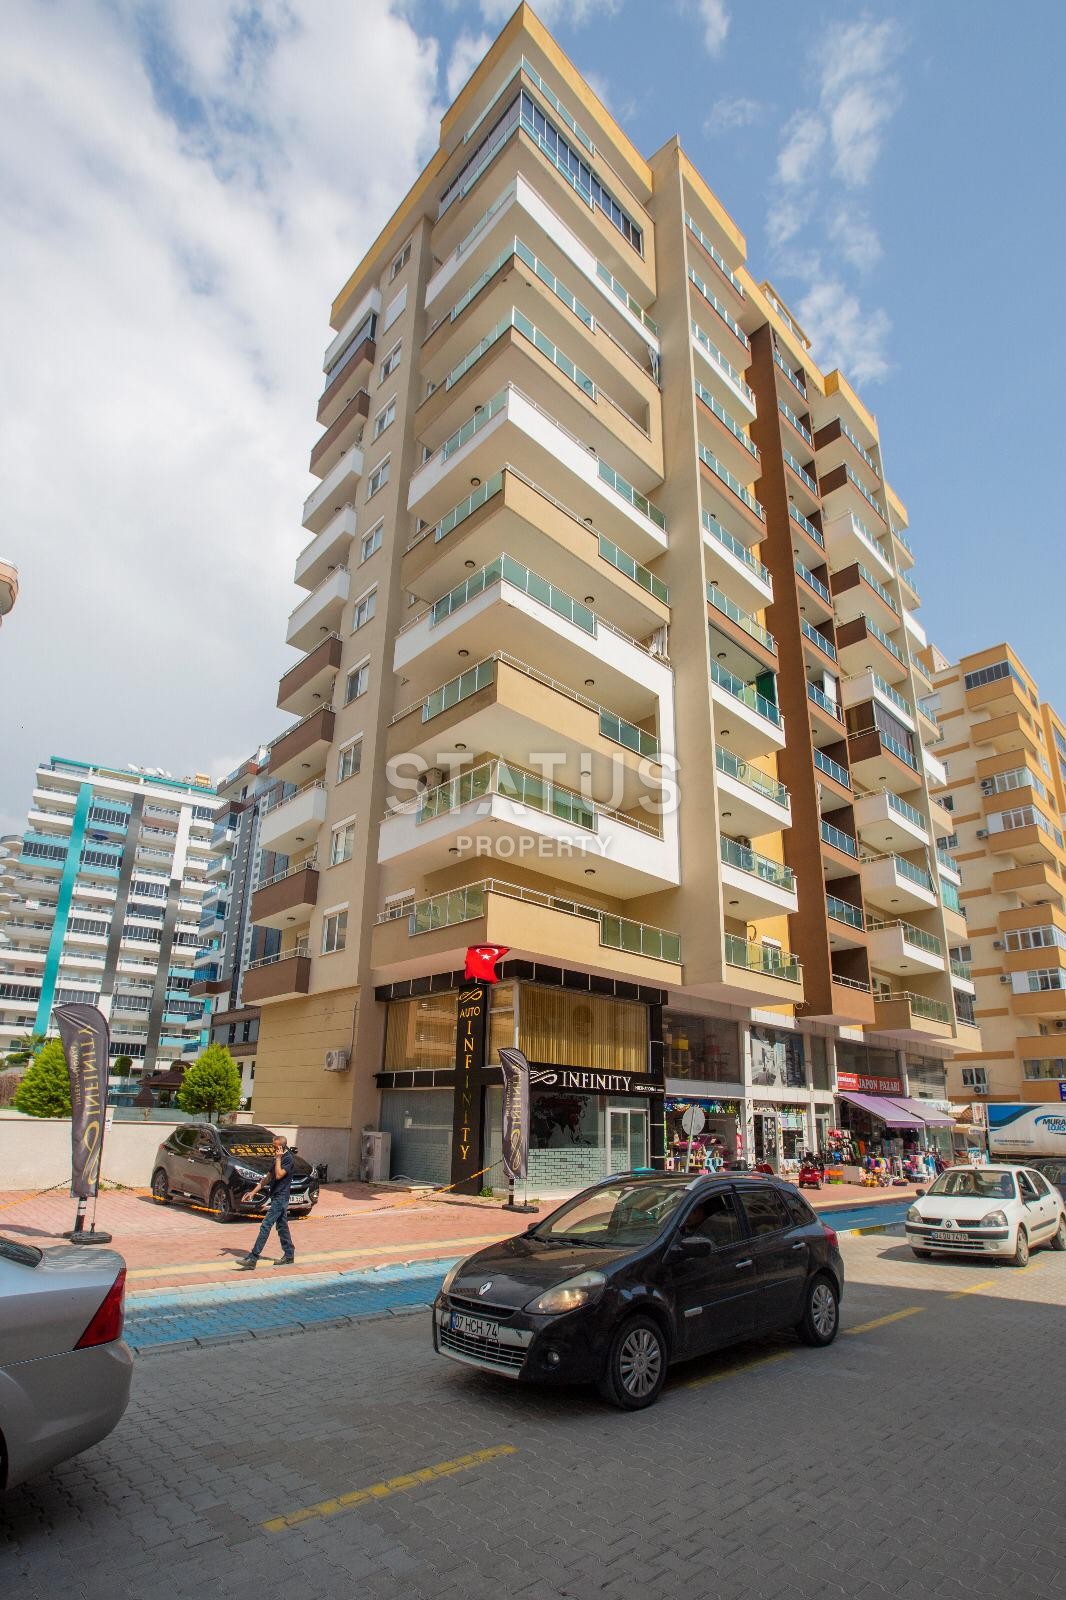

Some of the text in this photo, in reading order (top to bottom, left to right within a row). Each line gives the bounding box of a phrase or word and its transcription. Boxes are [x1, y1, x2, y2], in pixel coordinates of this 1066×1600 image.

[459, 1006, 481, 1019] AUTO
[461, 1020, 474, 1160] INFINITY
[558, 1070, 632, 1092] INFINITY
[858, 1078, 878, 1090] JAPON
[465, 1317, 483, 1335] HCH
